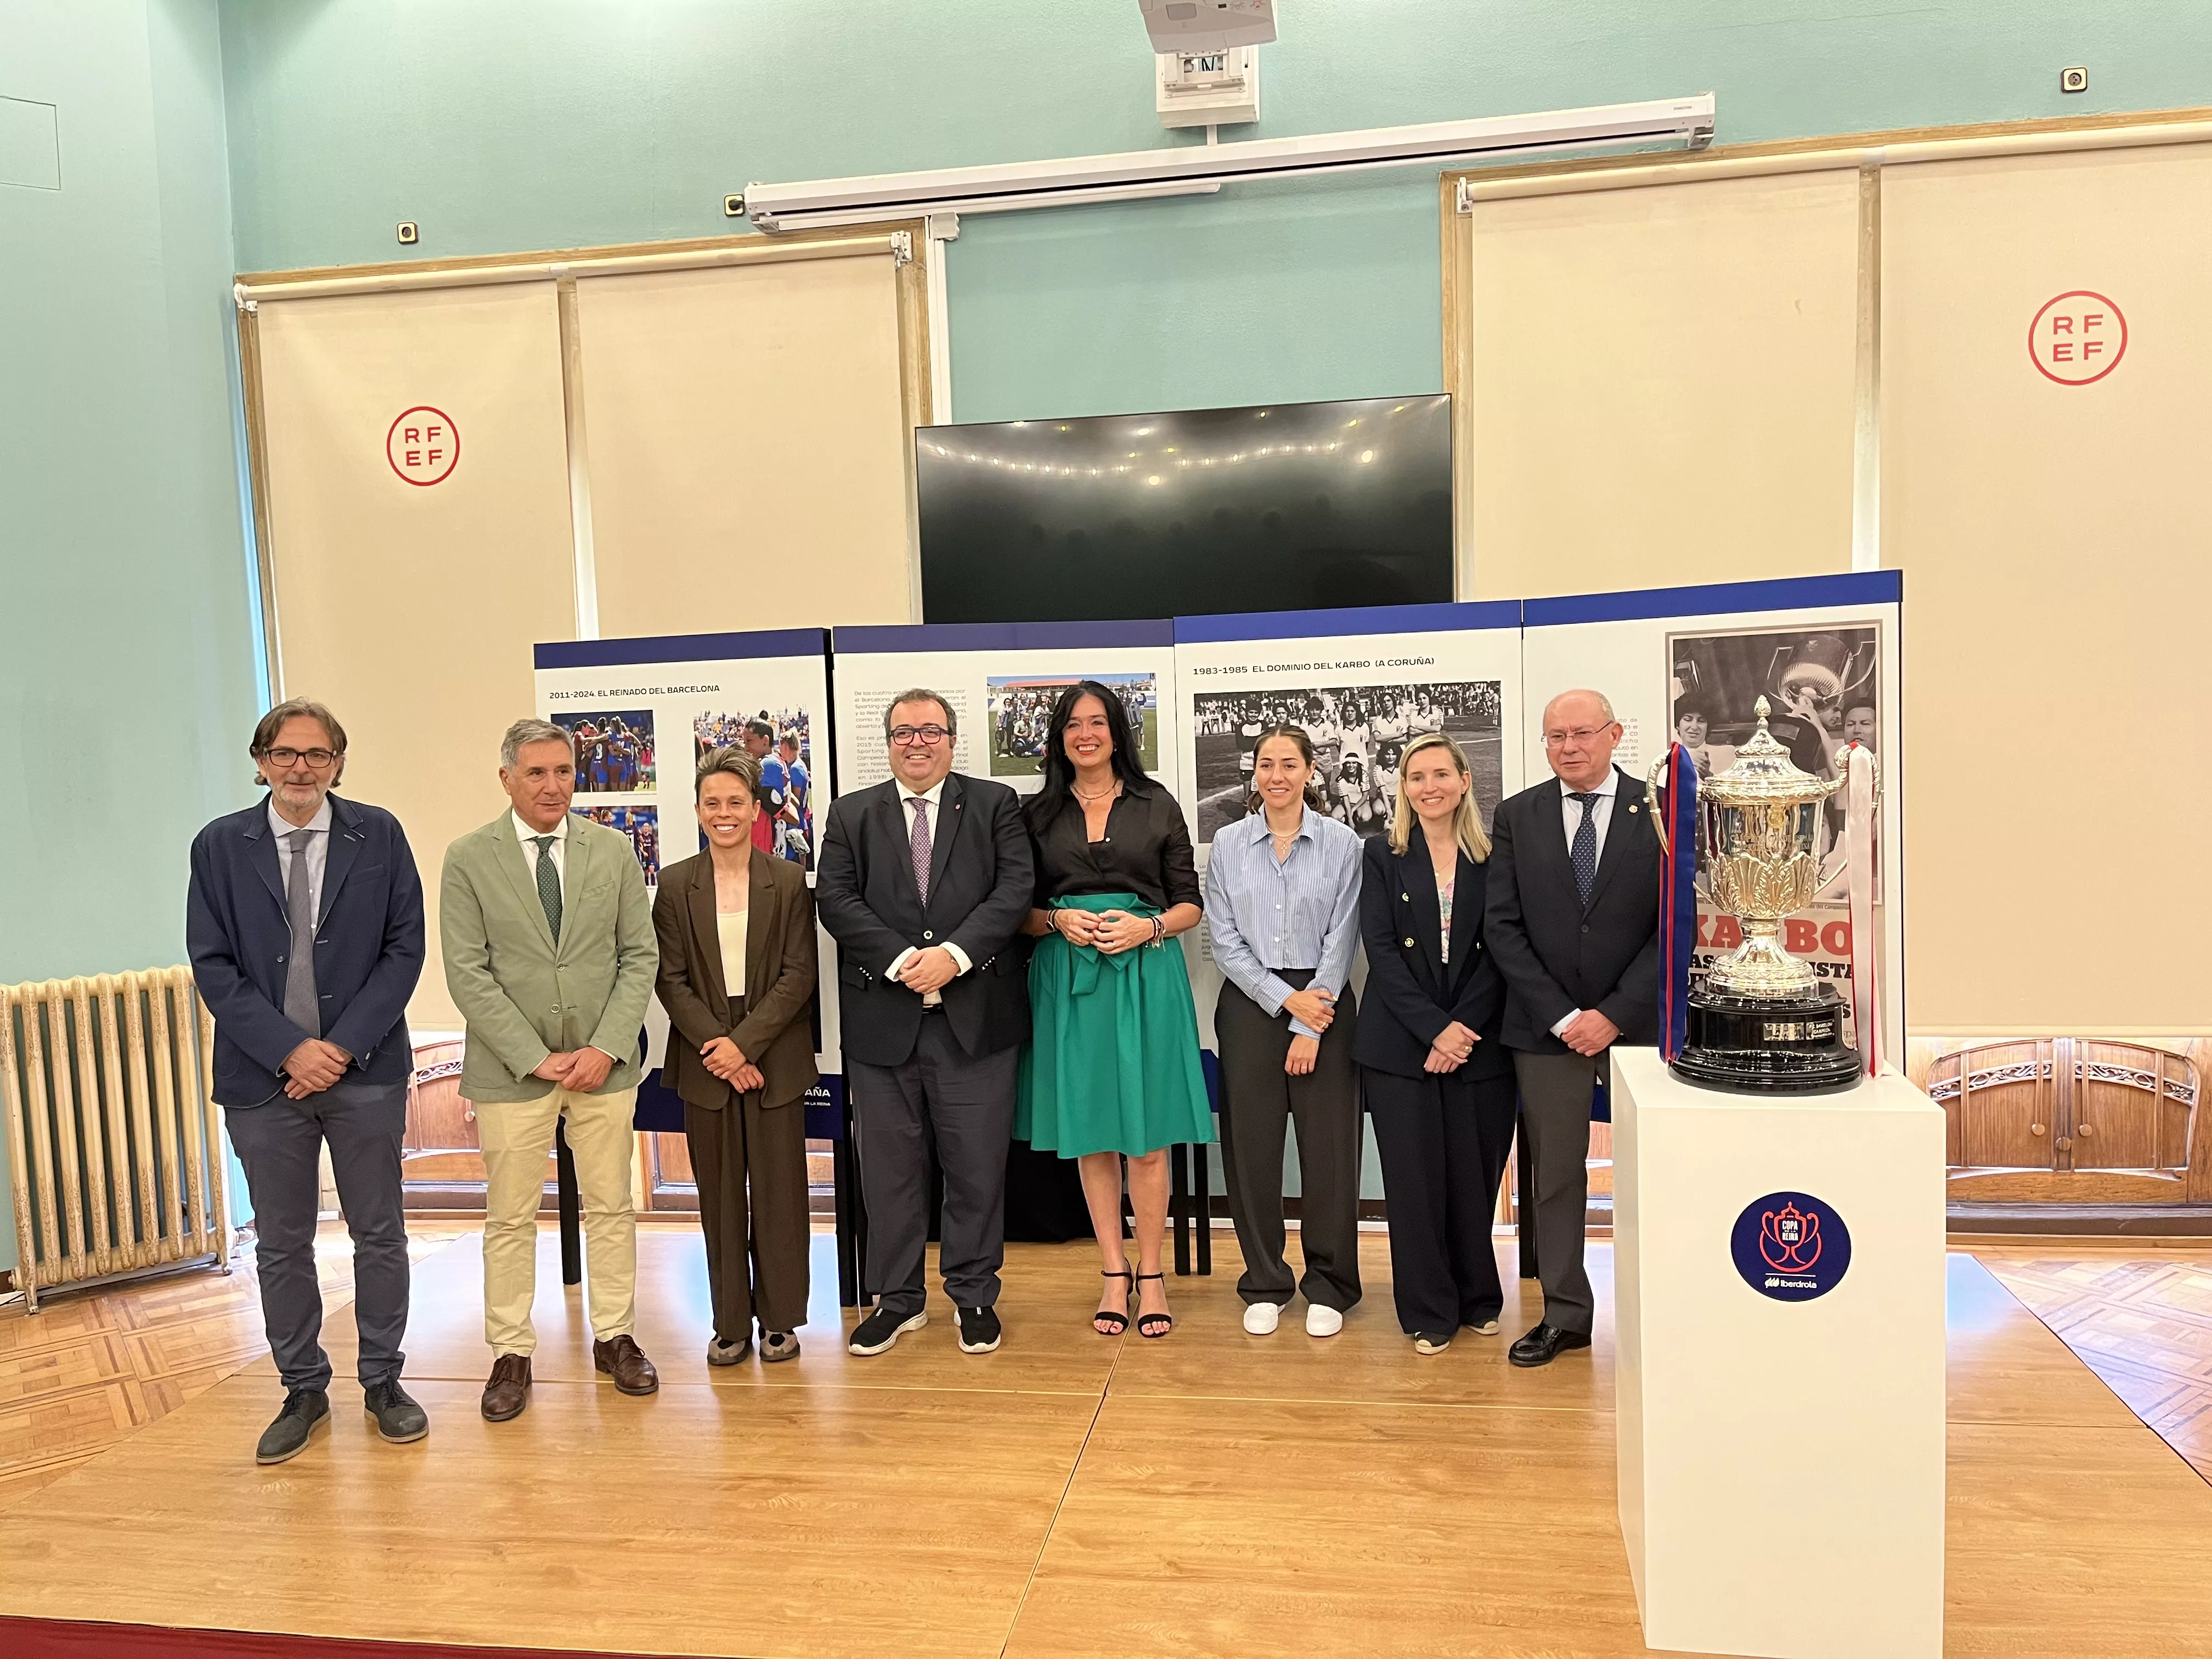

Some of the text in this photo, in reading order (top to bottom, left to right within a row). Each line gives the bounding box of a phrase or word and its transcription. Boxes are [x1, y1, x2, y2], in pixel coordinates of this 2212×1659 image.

[1193, 666, 1248, 675] 1983-1985
[1267, 663, 1311, 672] DOMINIO
[1335, 661, 1370, 669] KARBO
[1387, 656, 1434, 667] CORUÑA)
[667, 685, 720, 693] BARCELONA
[804, 1086, 831, 1097] AÑA
[1782, 1220, 1798, 1231] COPA
[1782, 1232, 1799, 1241] REINA
[1780, 1279, 1817, 1289] Iberdrola
